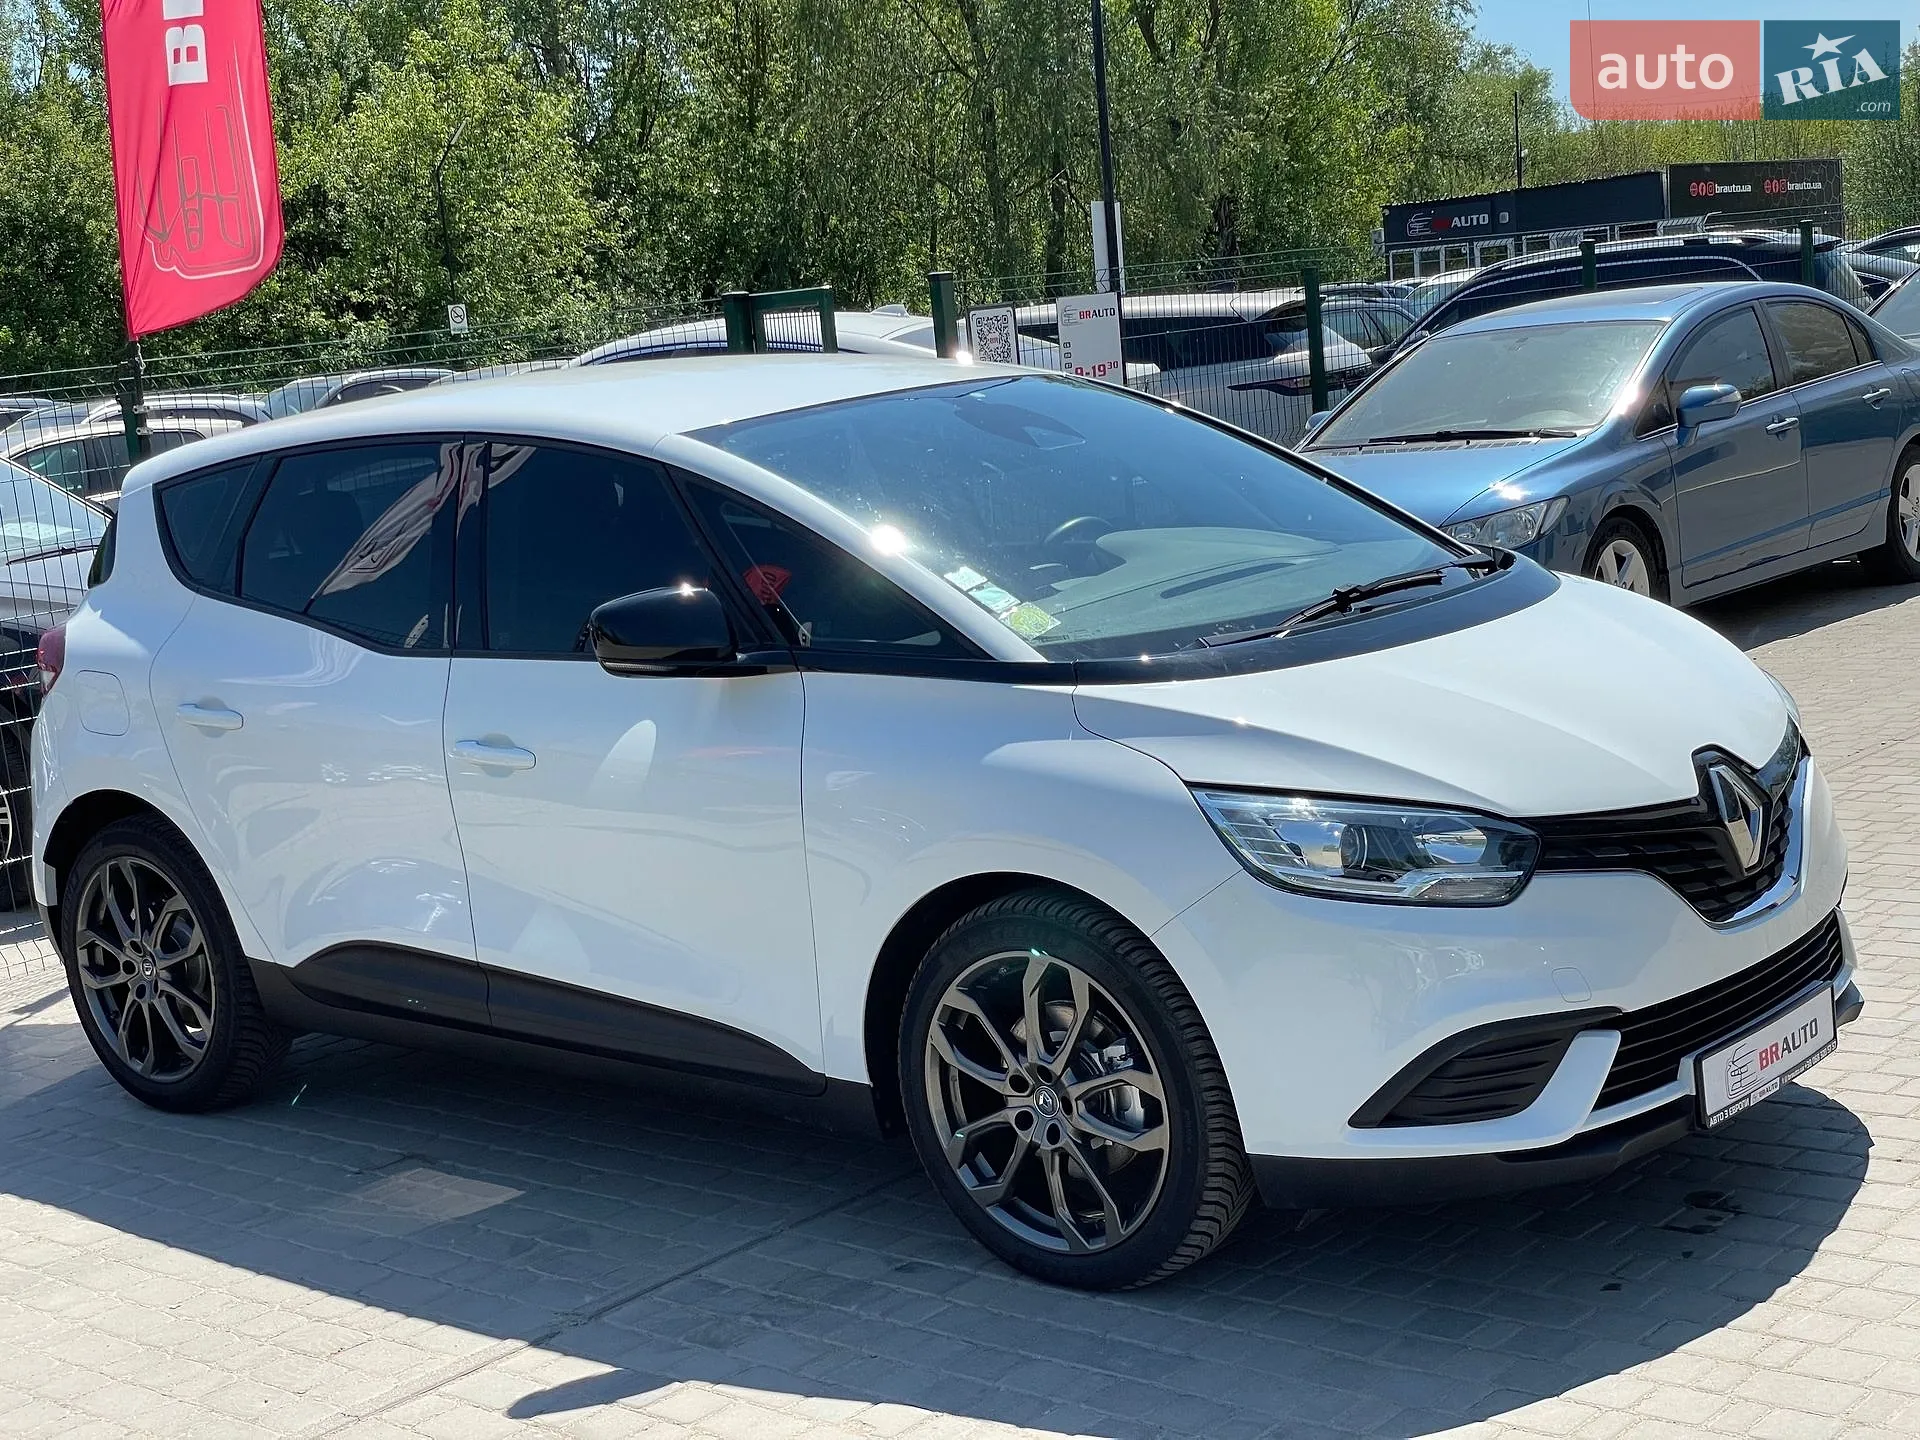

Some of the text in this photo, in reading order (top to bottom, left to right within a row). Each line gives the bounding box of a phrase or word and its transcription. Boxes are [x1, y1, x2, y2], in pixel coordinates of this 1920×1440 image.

[1715, 183, 1752, 194] brauto.ua
[1787, 181, 1822, 191] brauto.ua
[1079, 308, 1116, 319] BRAUTO
[1758, 1017, 1818, 1071] BRAUTO
